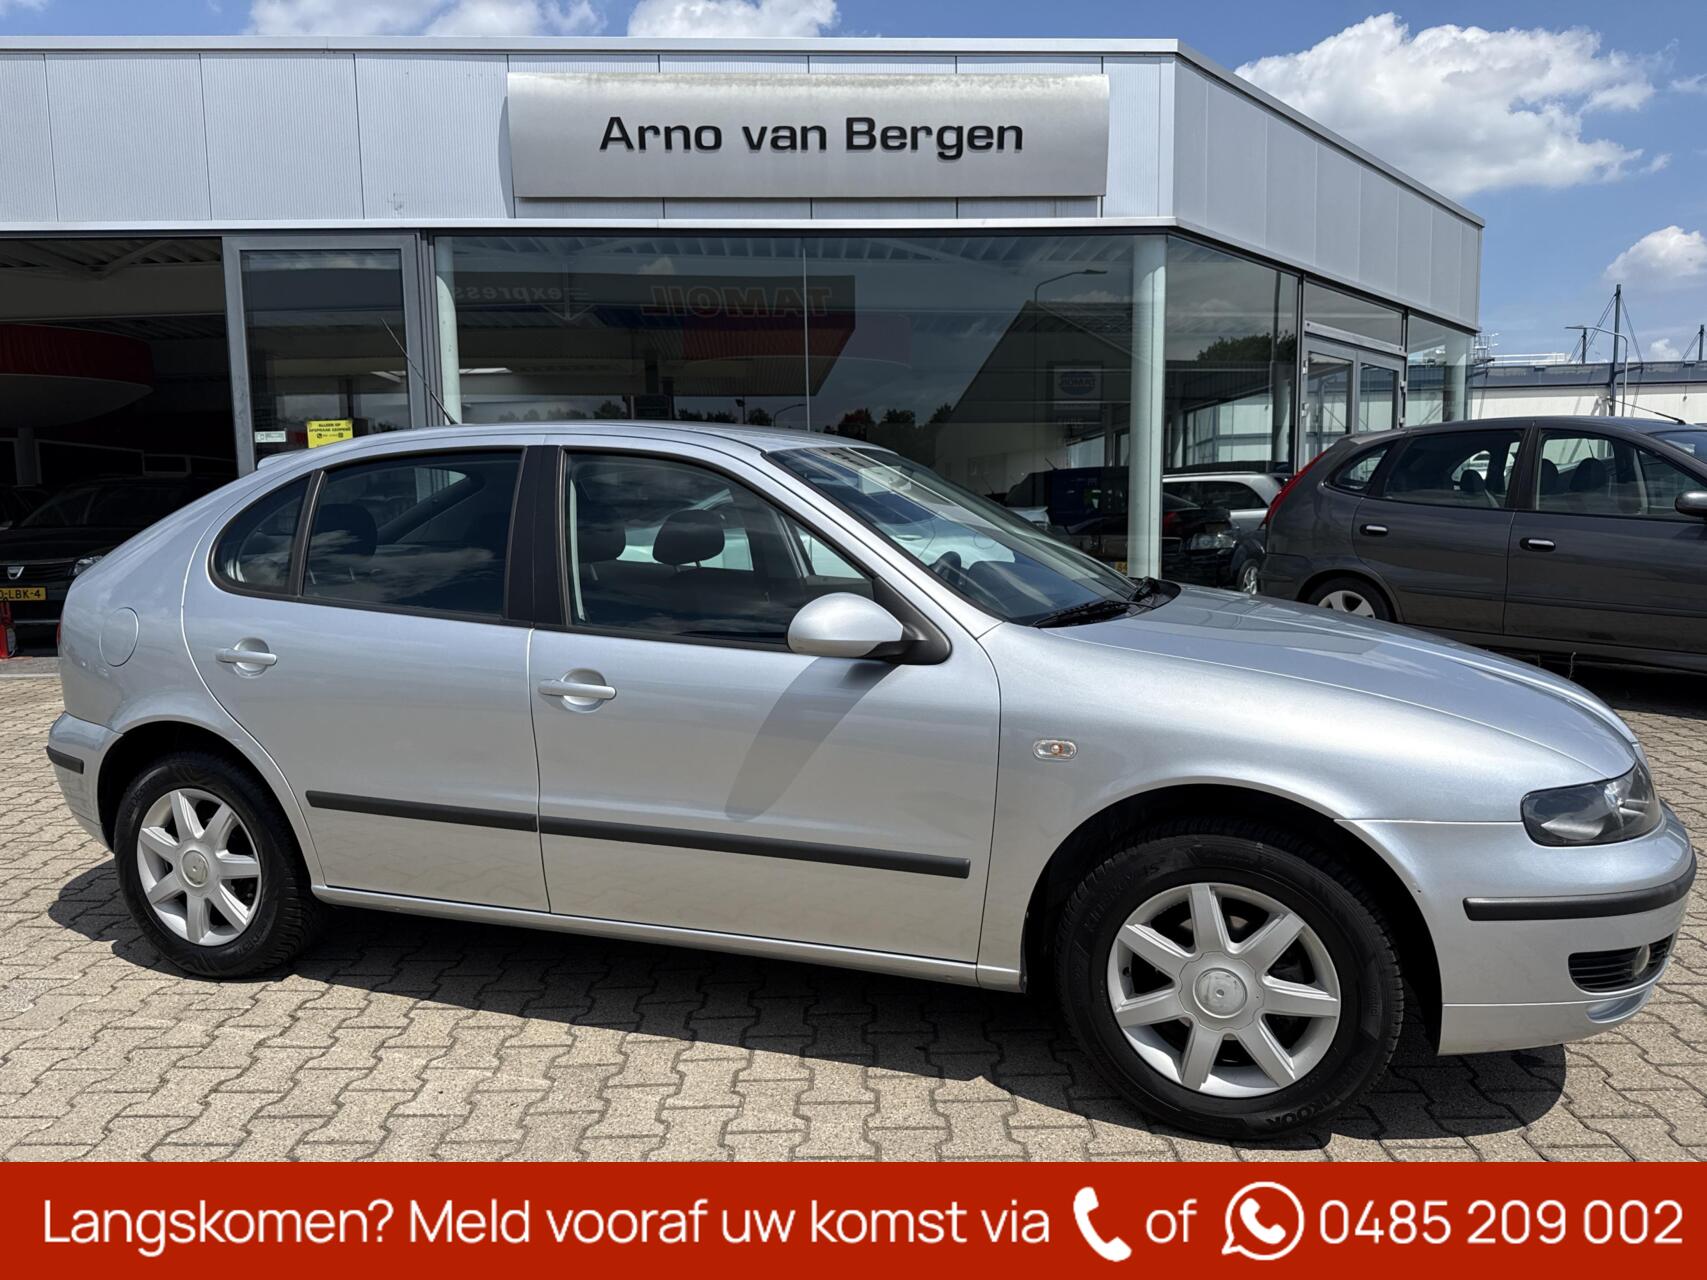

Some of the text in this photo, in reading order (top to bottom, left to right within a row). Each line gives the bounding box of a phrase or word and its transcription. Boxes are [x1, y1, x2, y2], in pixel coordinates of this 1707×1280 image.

[599, 116, 1023, 161] Arno van Bergen
